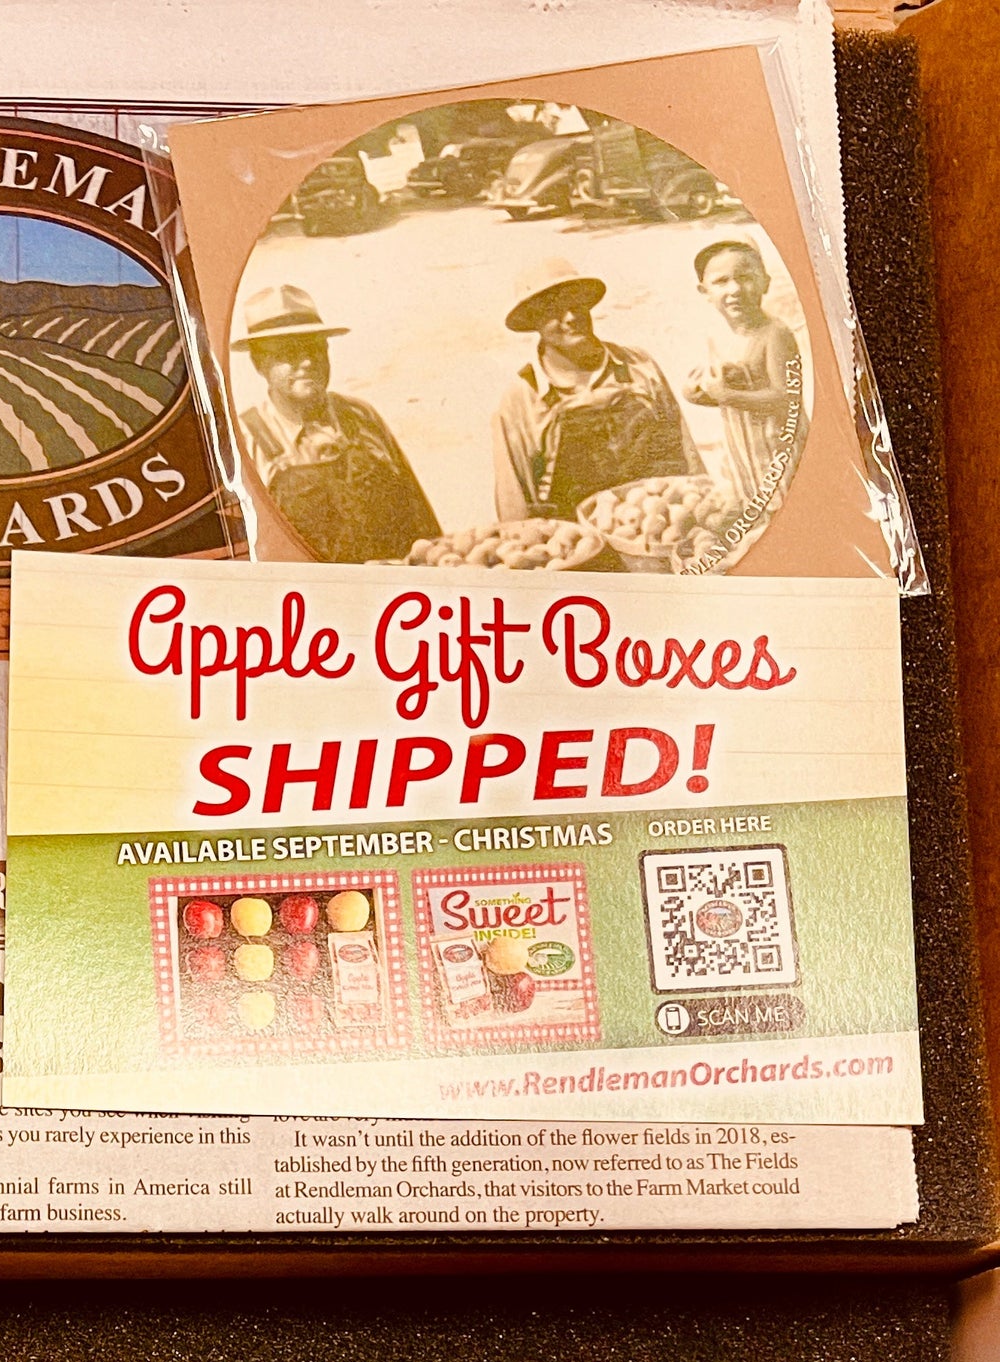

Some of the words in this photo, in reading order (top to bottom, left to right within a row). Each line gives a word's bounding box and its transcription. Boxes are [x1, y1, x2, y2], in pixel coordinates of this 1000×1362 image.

[785, 354, 803, 397] 1873.
[778, 401, 800, 443] Since
[725, 449, 790, 545] ORCHARDS.
[128, 584, 355, 719] Apple
[375, 591, 532, 728] Gift
[543, 595, 797, 691] Boxes
[191, 723, 717, 817] SHIPPED!
[648, 818, 717, 837] ORDER
[720, 815, 773, 834] HERE
[117, 837, 266, 866] AVAILABLE
[273, 831, 433, 861] SEPTEMBER
[453, 823, 614, 852] CHRISTMAS
[440, 886, 571, 931] Sweet
[474, 896, 532, 907] SOMETHING
[473, 927, 537, 942] INSIDE!
[697, 1009, 749, 1026] SCAN
[754, 1006, 785, 1023] ME
[438, 1053, 895, 1101] www.RendlemanOrchards.com
[7, 1130, 40, 1147] you
[45, 1125, 95, 1148] rarely
[99, 1126, 194, 1149] experience
[198, 1126, 215, 1145] in
[219, 1126, 251, 1144] this
[294, 1130, 308, 1148] It
[312, 1129, 370, 1147] wasn't
[374, 1129, 414, 1147] until
[419, 1129, 446, 1147] the
[450, 1129, 522, 1147] addition
[526, 1128, 547, 1147] of
[549, 1128, 577, 1146] the
[581, 1128, 639, 1146] flower
[643, 1128, 690, 1145] fields
[695, 1127, 712, 1145] in
[716, 1127, 767, 1146] 2018,
[770, 1131, 796, 1144] es-
[274, 1155, 352, 1173] tablished
[355, 1155, 377, 1178] by
[381, 1155, 408, 1173] the
[412, 1154, 447, 1173] fifth
[451, 1154, 551, 1178] generation,
[551, 1159, 591, 1172] now
[592, 1153, 662, 1172] referred
[664, 1156, 684, 1171] to
[685, 1157, 705, 1171] as
[705, 1152, 742, 1170] The
[745, 1152, 799, 1170] Fields
[48, 1176, 100, 1195] farms
[108, 1177, 125, 1195] in
[133, 1178, 210, 1196] America
[219, 1177, 252, 1195] still
[275, 1184, 291, 1199] at
[294, 1180, 393, 1198] Rendleman
[396, 1180, 482, 1200] Orchards,
[484, 1180, 517, 1197] that
[520, 1179, 583, 1197] visitors
[585, 1182, 604, 1197] to
[606, 1179, 633, 1196] the
[637, 1178, 683, 1196] Farm
[686, 1178, 749, 1196] Market
[751, 1177, 800, 1195] could
[0, 1203, 41, 1221] farm
[47, 1203, 127, 1221] business.
[275, 1206, 345, 1229] actually
[350, 1206, 394, 1224] walk
[398, 1205, 460, 1224] around
[465, 1210, 487, 1223] on
[492, 1205, 520, 1223] the
[524, 1208, 605, 1229] property.
